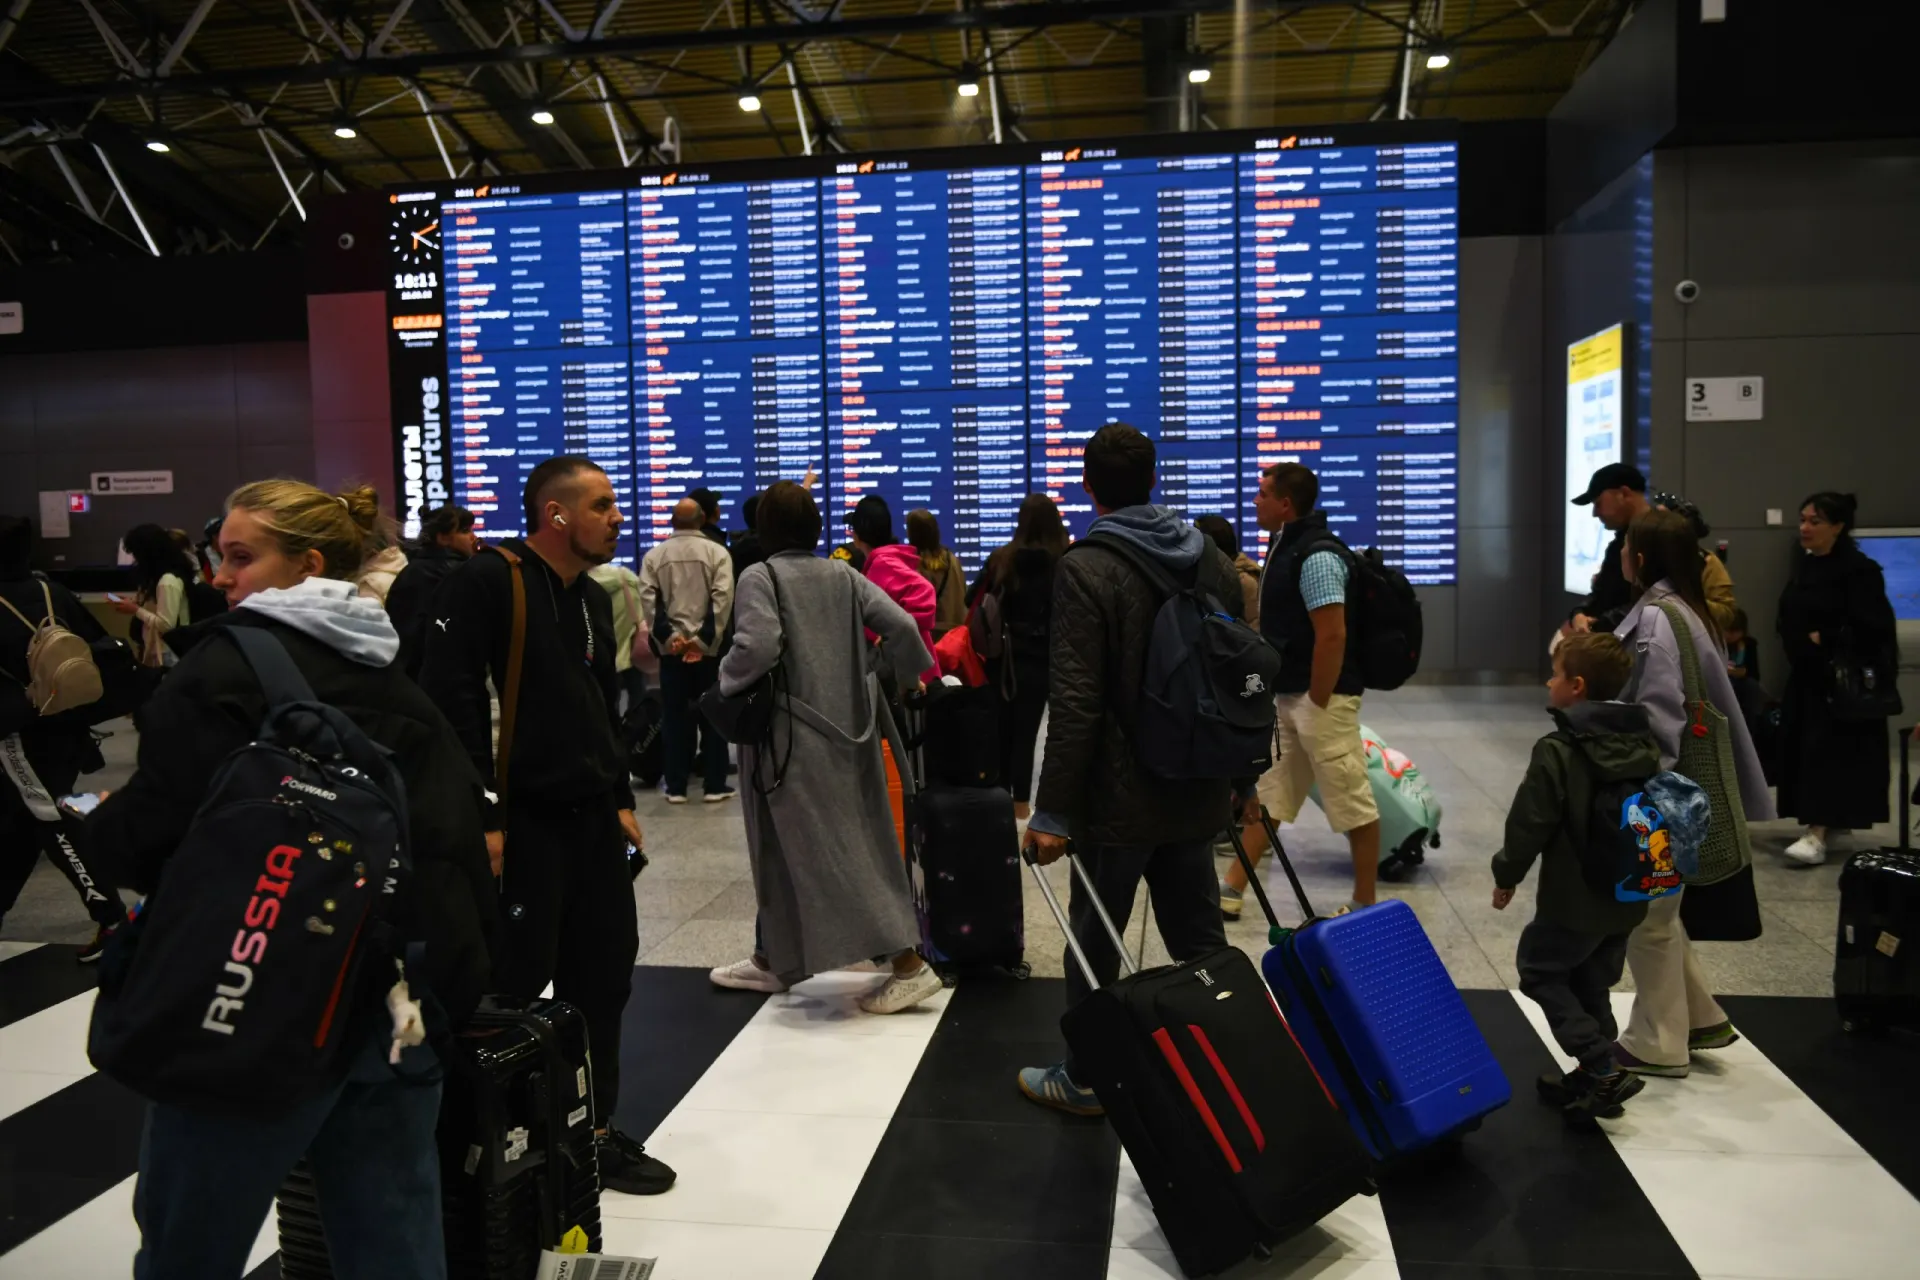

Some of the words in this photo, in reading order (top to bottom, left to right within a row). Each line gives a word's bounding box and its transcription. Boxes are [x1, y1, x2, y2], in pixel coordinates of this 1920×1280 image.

[1691, 383, 1705, 402] 3
[280, 775, 337, 801] FORWARD
[57, 833, 95, 885] DEMIX
[201, 843, 303, 1035] RUSSIA
